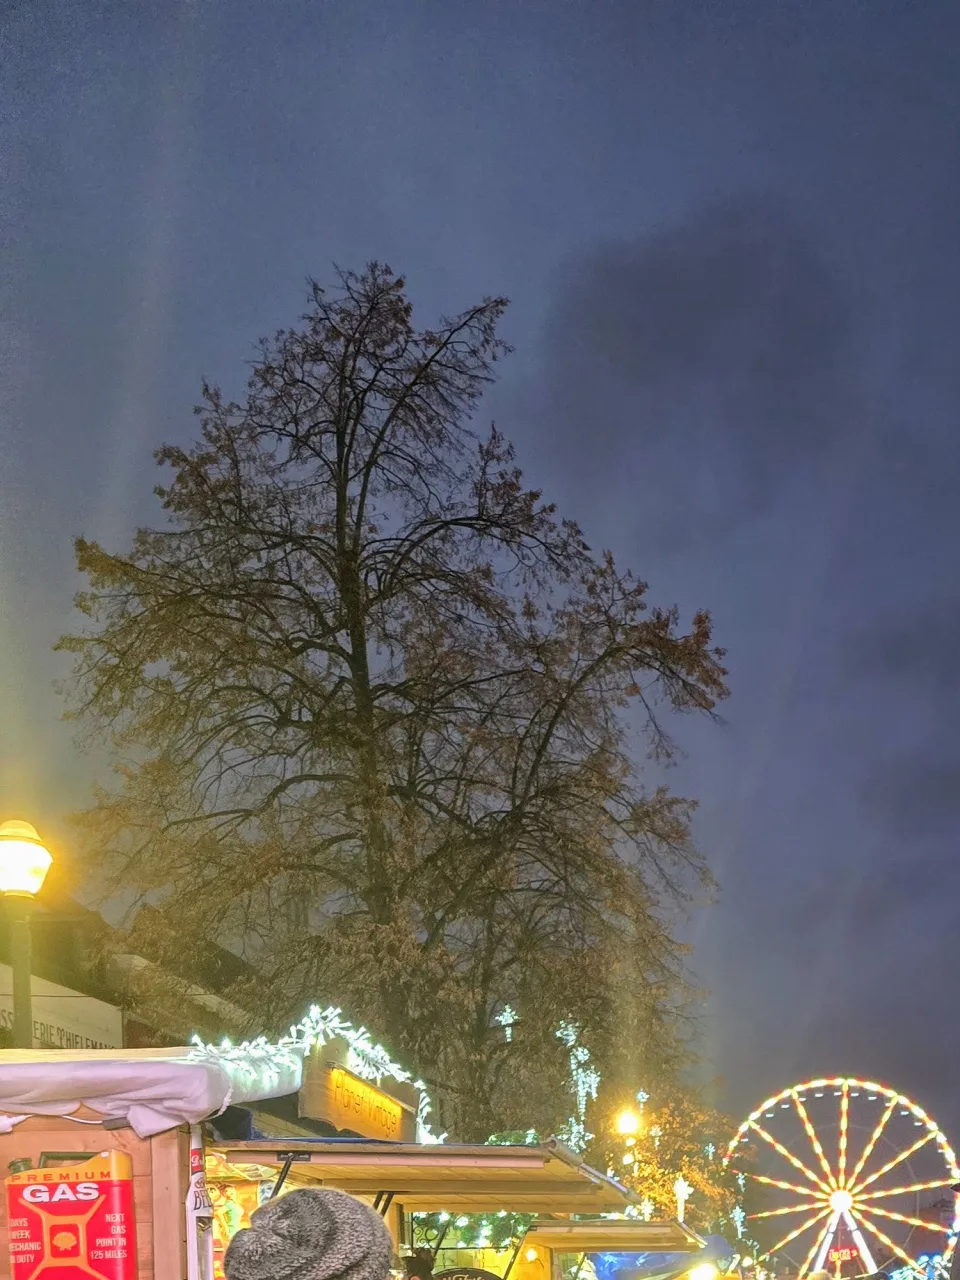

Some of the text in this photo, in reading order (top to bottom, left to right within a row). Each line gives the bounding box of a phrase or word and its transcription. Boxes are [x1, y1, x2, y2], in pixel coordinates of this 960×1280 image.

[364, 1088, 397, 1137] Vintage
[12, 1171, 111, 1182] PREMIUM
[23, 1182, 99, 1203] GAS
[105, 1213, 125, 1222] NEXT
[111, 1225, 126, 1234] GAS
[9, 1242, 42, 1251] ECHANIC
[90, 1250, 127, 1260] 125 MILES
